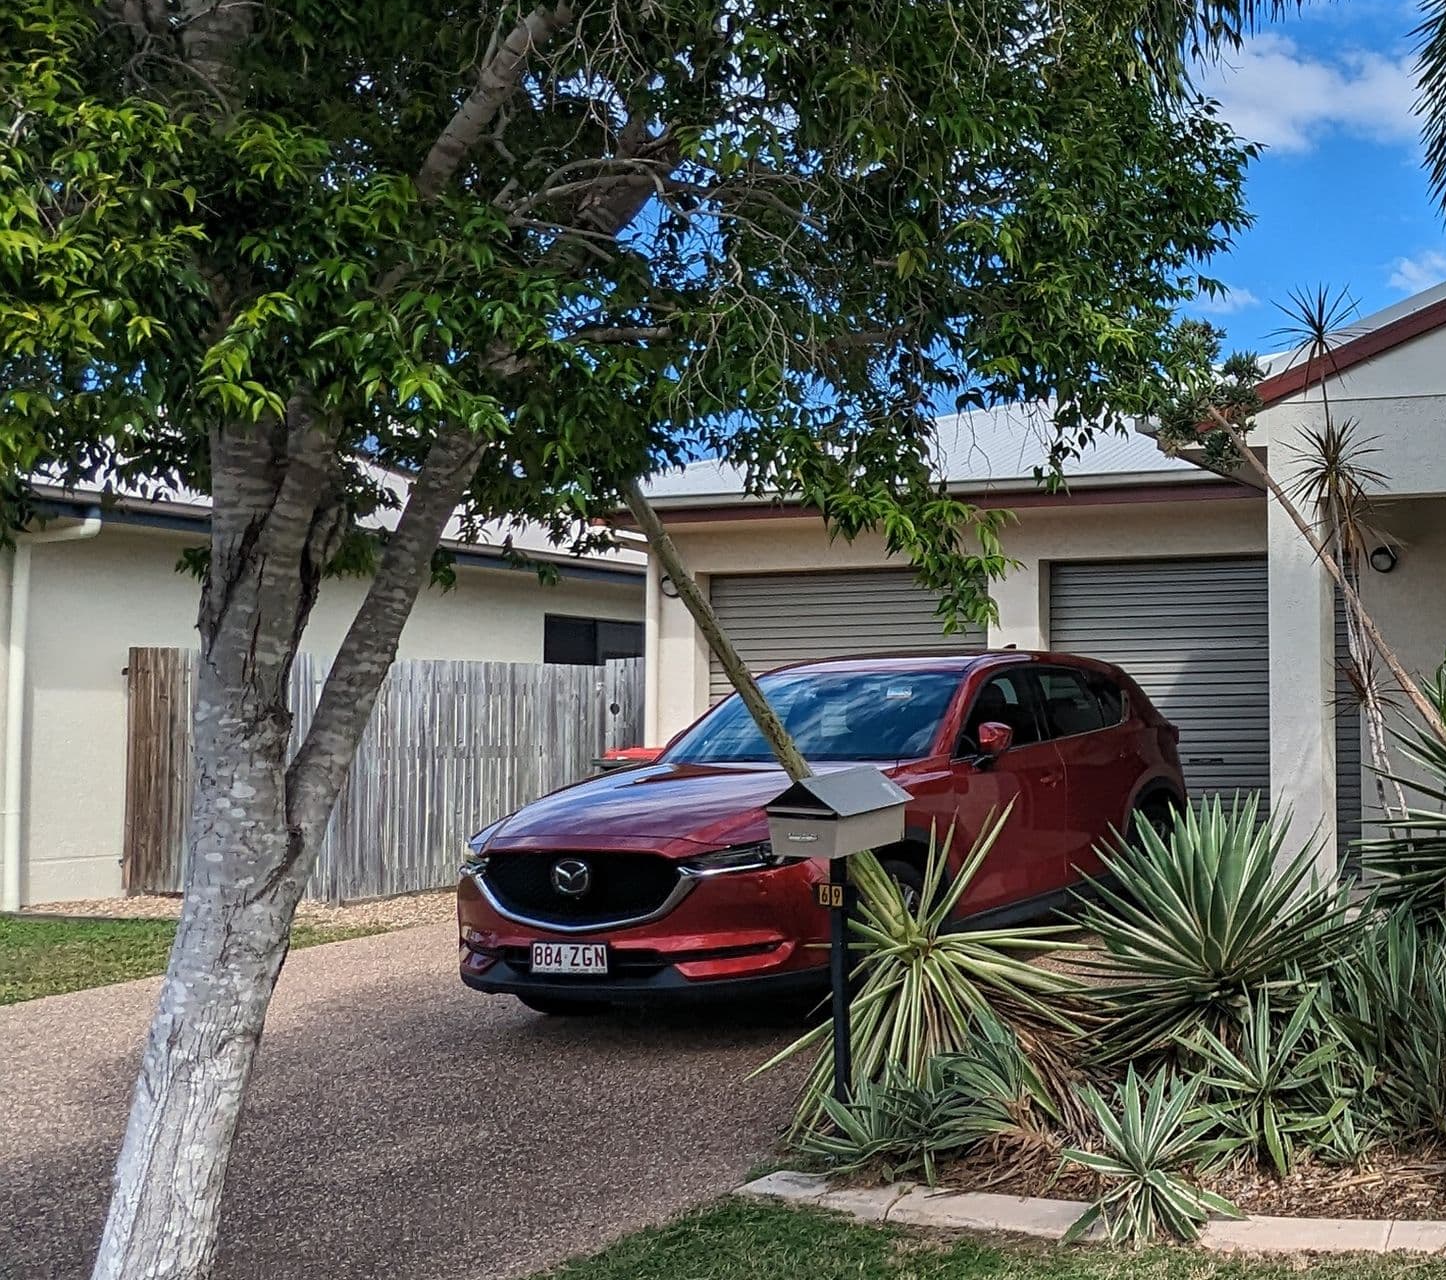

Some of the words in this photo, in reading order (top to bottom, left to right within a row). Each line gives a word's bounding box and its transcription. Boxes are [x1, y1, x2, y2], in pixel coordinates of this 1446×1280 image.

[821, 886, 841, 905] 69
[534, 946, 562, 967] 884
[569, 946, 606, 968] ZGN
